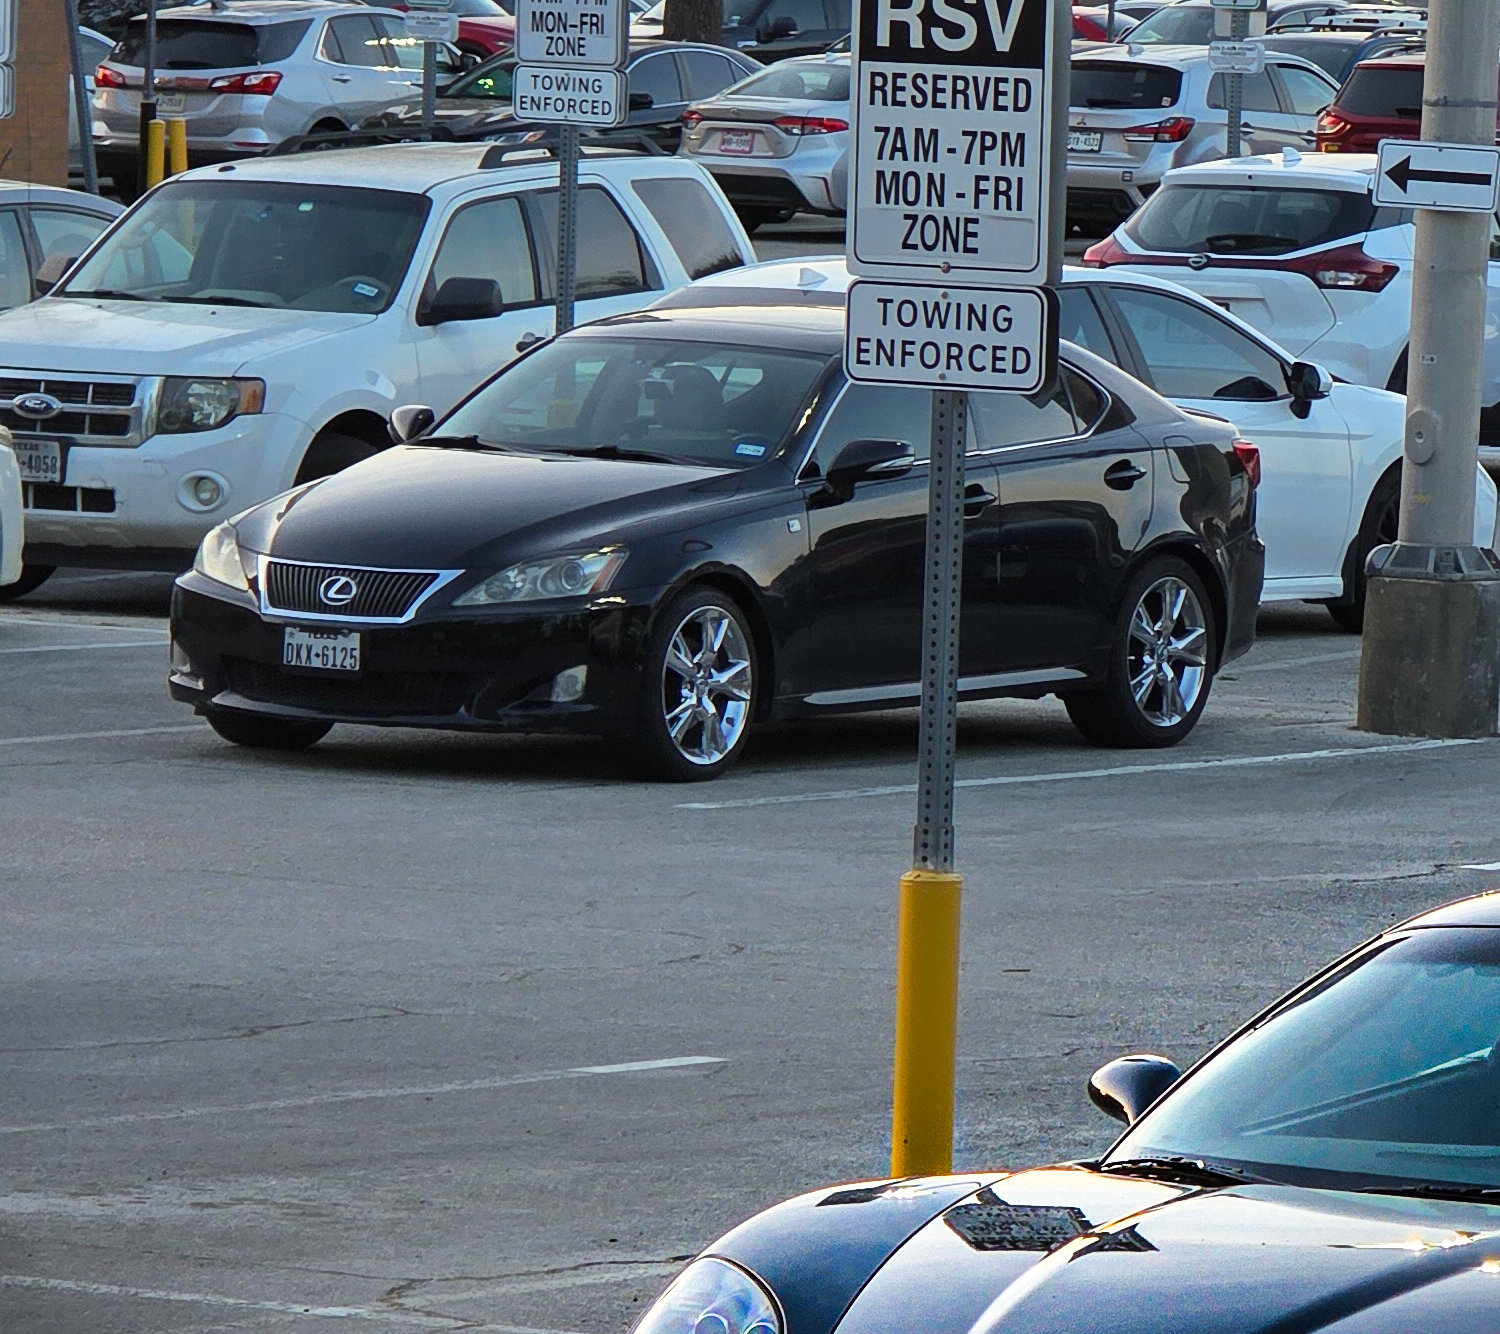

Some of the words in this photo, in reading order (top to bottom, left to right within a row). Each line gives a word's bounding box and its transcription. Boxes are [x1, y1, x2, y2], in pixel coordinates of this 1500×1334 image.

[545, 36, 587, 57] ZONE
[530, 74, 603, 94] TOWING
[869, 71, 1032, 113] RESERVED
[519, 95, 612, 116] ENFORCED
[901, 213, 980, 254] ZONE
[877, 297, 1013, 333] TOWING
[855, 337, 1032, 375] ENFORCED
